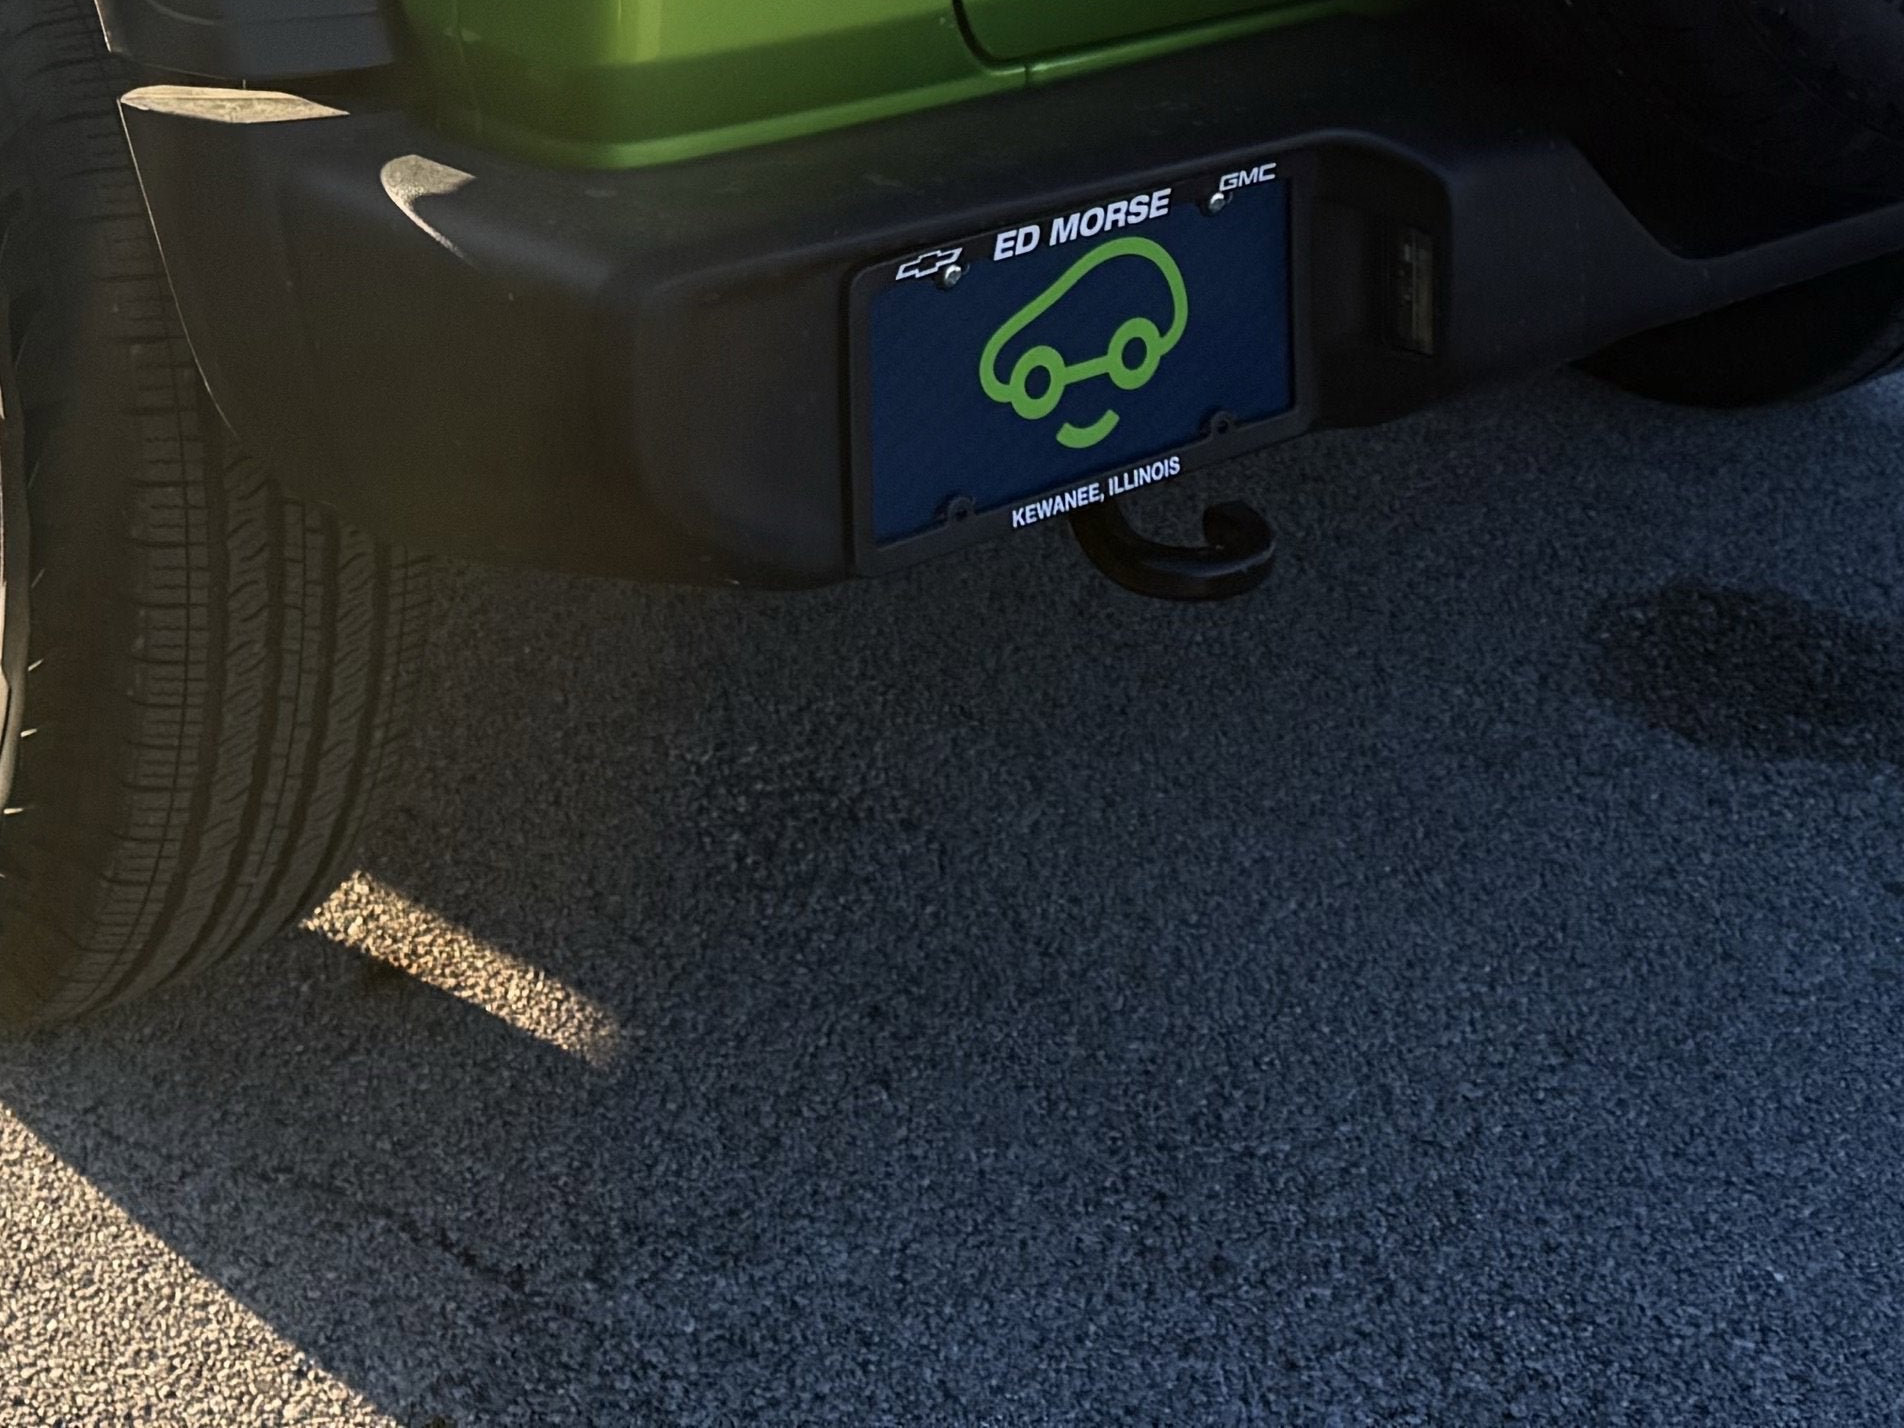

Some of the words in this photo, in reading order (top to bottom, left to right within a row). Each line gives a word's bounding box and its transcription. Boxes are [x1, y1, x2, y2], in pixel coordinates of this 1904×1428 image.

[1218, 162, 1278, 192] GMC
[993, 224, 1042, 262] ED
[1049, 187, 1173, 247] MORSE
[1011, 482, 1105, 529] KEWANEE,
[1108, 455, 1181, 498] ILLINOIS
